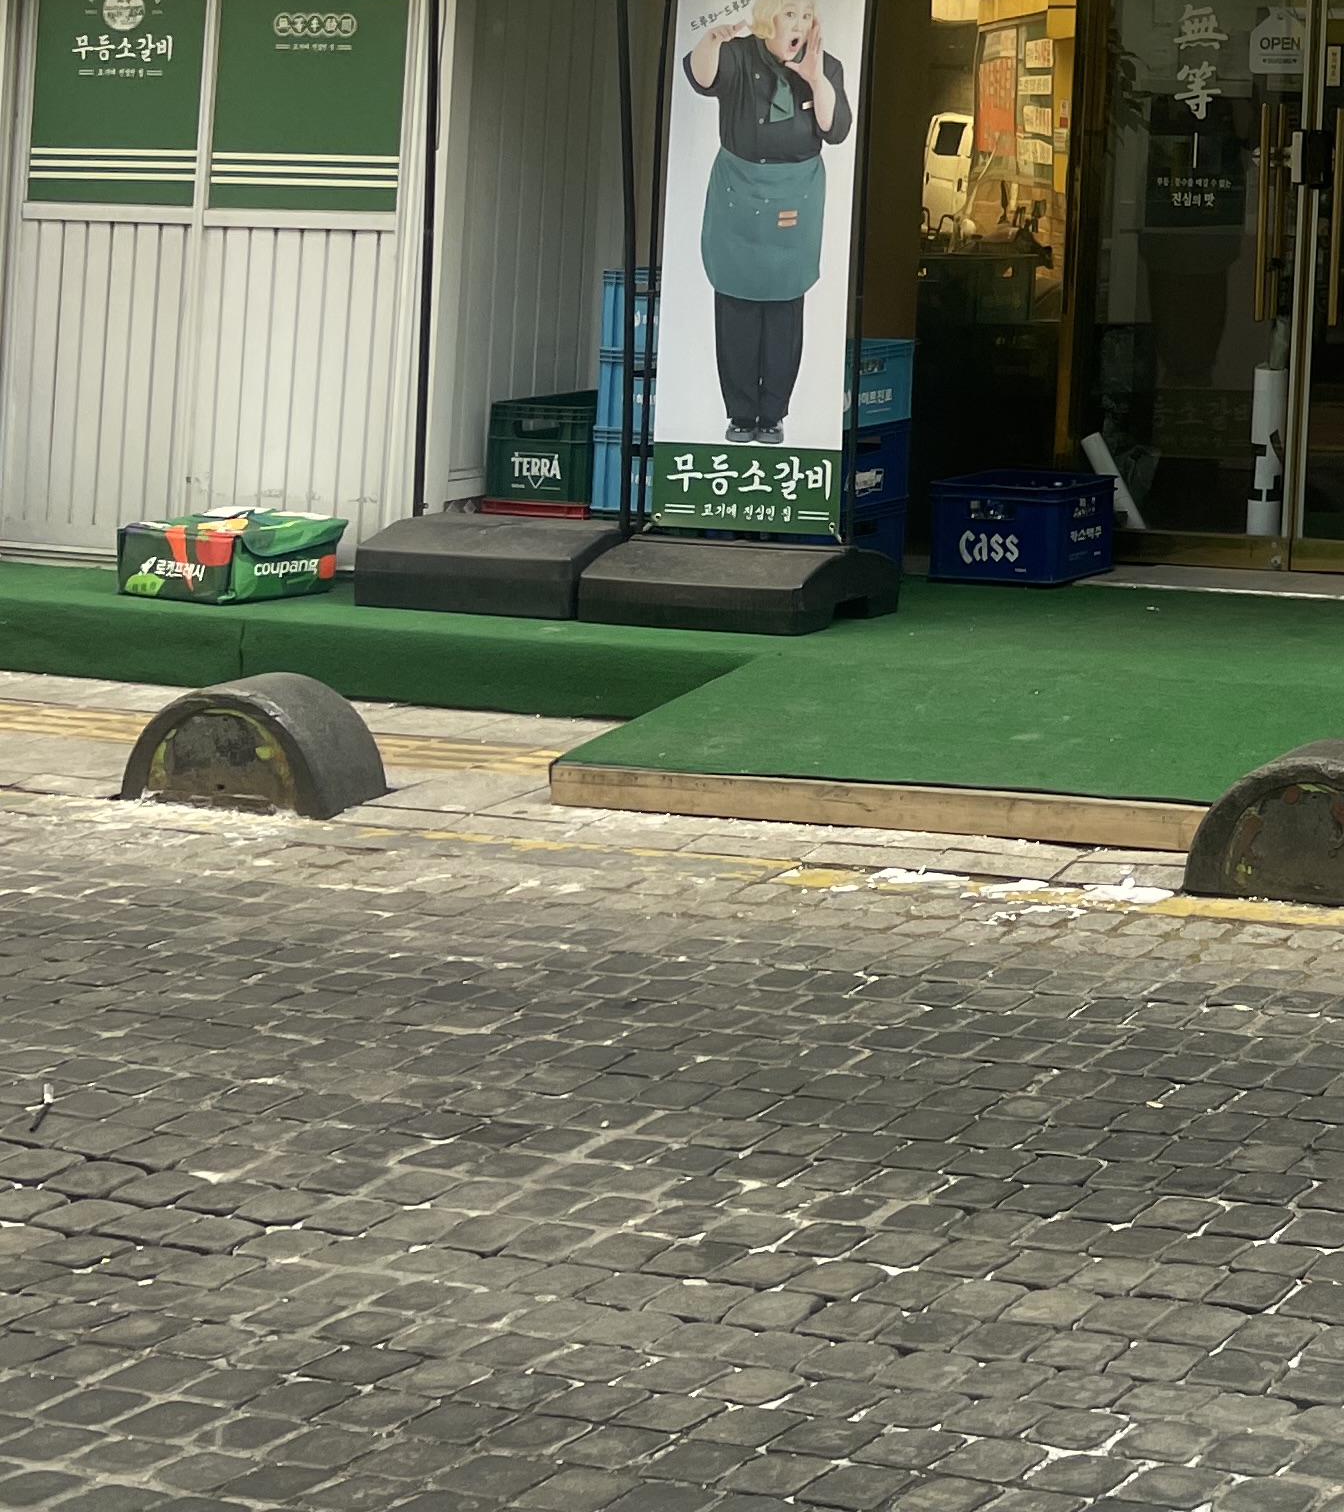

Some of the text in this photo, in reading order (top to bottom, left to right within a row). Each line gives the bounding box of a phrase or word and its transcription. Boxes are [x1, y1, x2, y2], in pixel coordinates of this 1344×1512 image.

[71, 33, 173, 62] 무등소갈비
[1259, 37, 1301, 50] OPEN
[858, 389, 892, 406] 이트진로
[511, 452, 561, 479] TERRA
[666, 453, 832, 501] 무등소갈비
[701, 503, 791, 522] 고기에 진심인 집
[959, 530, 1019, 564] Cass
[155, 559, 206, 582] 로켓프레시
[254, 558, 319, 578] coupang
